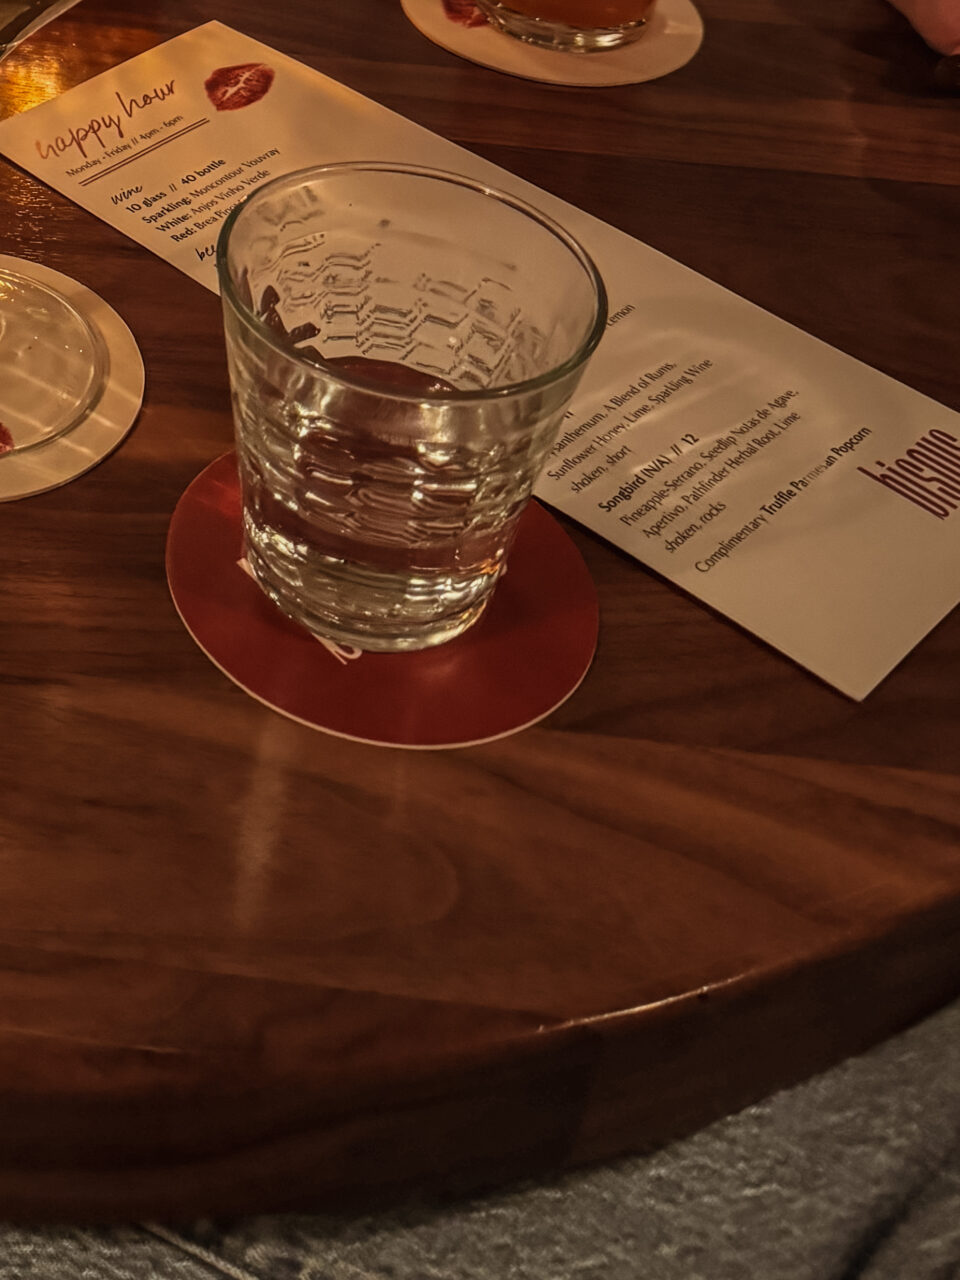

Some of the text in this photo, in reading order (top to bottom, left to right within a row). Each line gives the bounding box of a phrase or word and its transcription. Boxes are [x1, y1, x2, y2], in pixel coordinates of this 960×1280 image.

[35, 80, 175, 160] happy hour
[65, 157, 102, 178] Monday
[105, 142, 132, 159] Friday
[139, 126, 160, 141] 4pm
[163, 115, 184, 128] 6pm
[110, 185, 143, 205] wine
[126, 202, 142, 214] 10
[142, 191, 167, 208] glass
[181, 174, 197, 186] 40
[196, 158, 226, 178] bottle
[142, 147, 281, 225] Sparkling: Moncontour Vouvray
[155, 169, 271, 233] White: Anjos Vinho Verde
[170, 225, 197, 243] Red:
[194, 214, 219, 231] Brea
[547, 444, 597, 480] Sunflower
[647, 374, 694, 405] Sparkling
[684, 358, 714, 380] Wine
[603, 403, 616, 413] A
[610, 384, 640, 407] Blend
[638, 376, 650, 392] of
[680, 467, 730, 505] Pathfinder
[725, 443, 760, 471] Herbal
[773, 410, 801, 431] Lime
[700, 434, 738, 461] Seedlip
[730, 416, 761, 436] Notas
[756, 407, 771, 421] de
[570, 444, 633, 494] shaken, short
[598, 472, 647, 513] Songbird
[641, 453, 673, 478] (N/A)
[681, 433, 700, 446] 12
[694, 426, 872, 573] Complimentary Truffle Parmesan Popcorn
[664, 501, 727, 554] shaken, rocks
